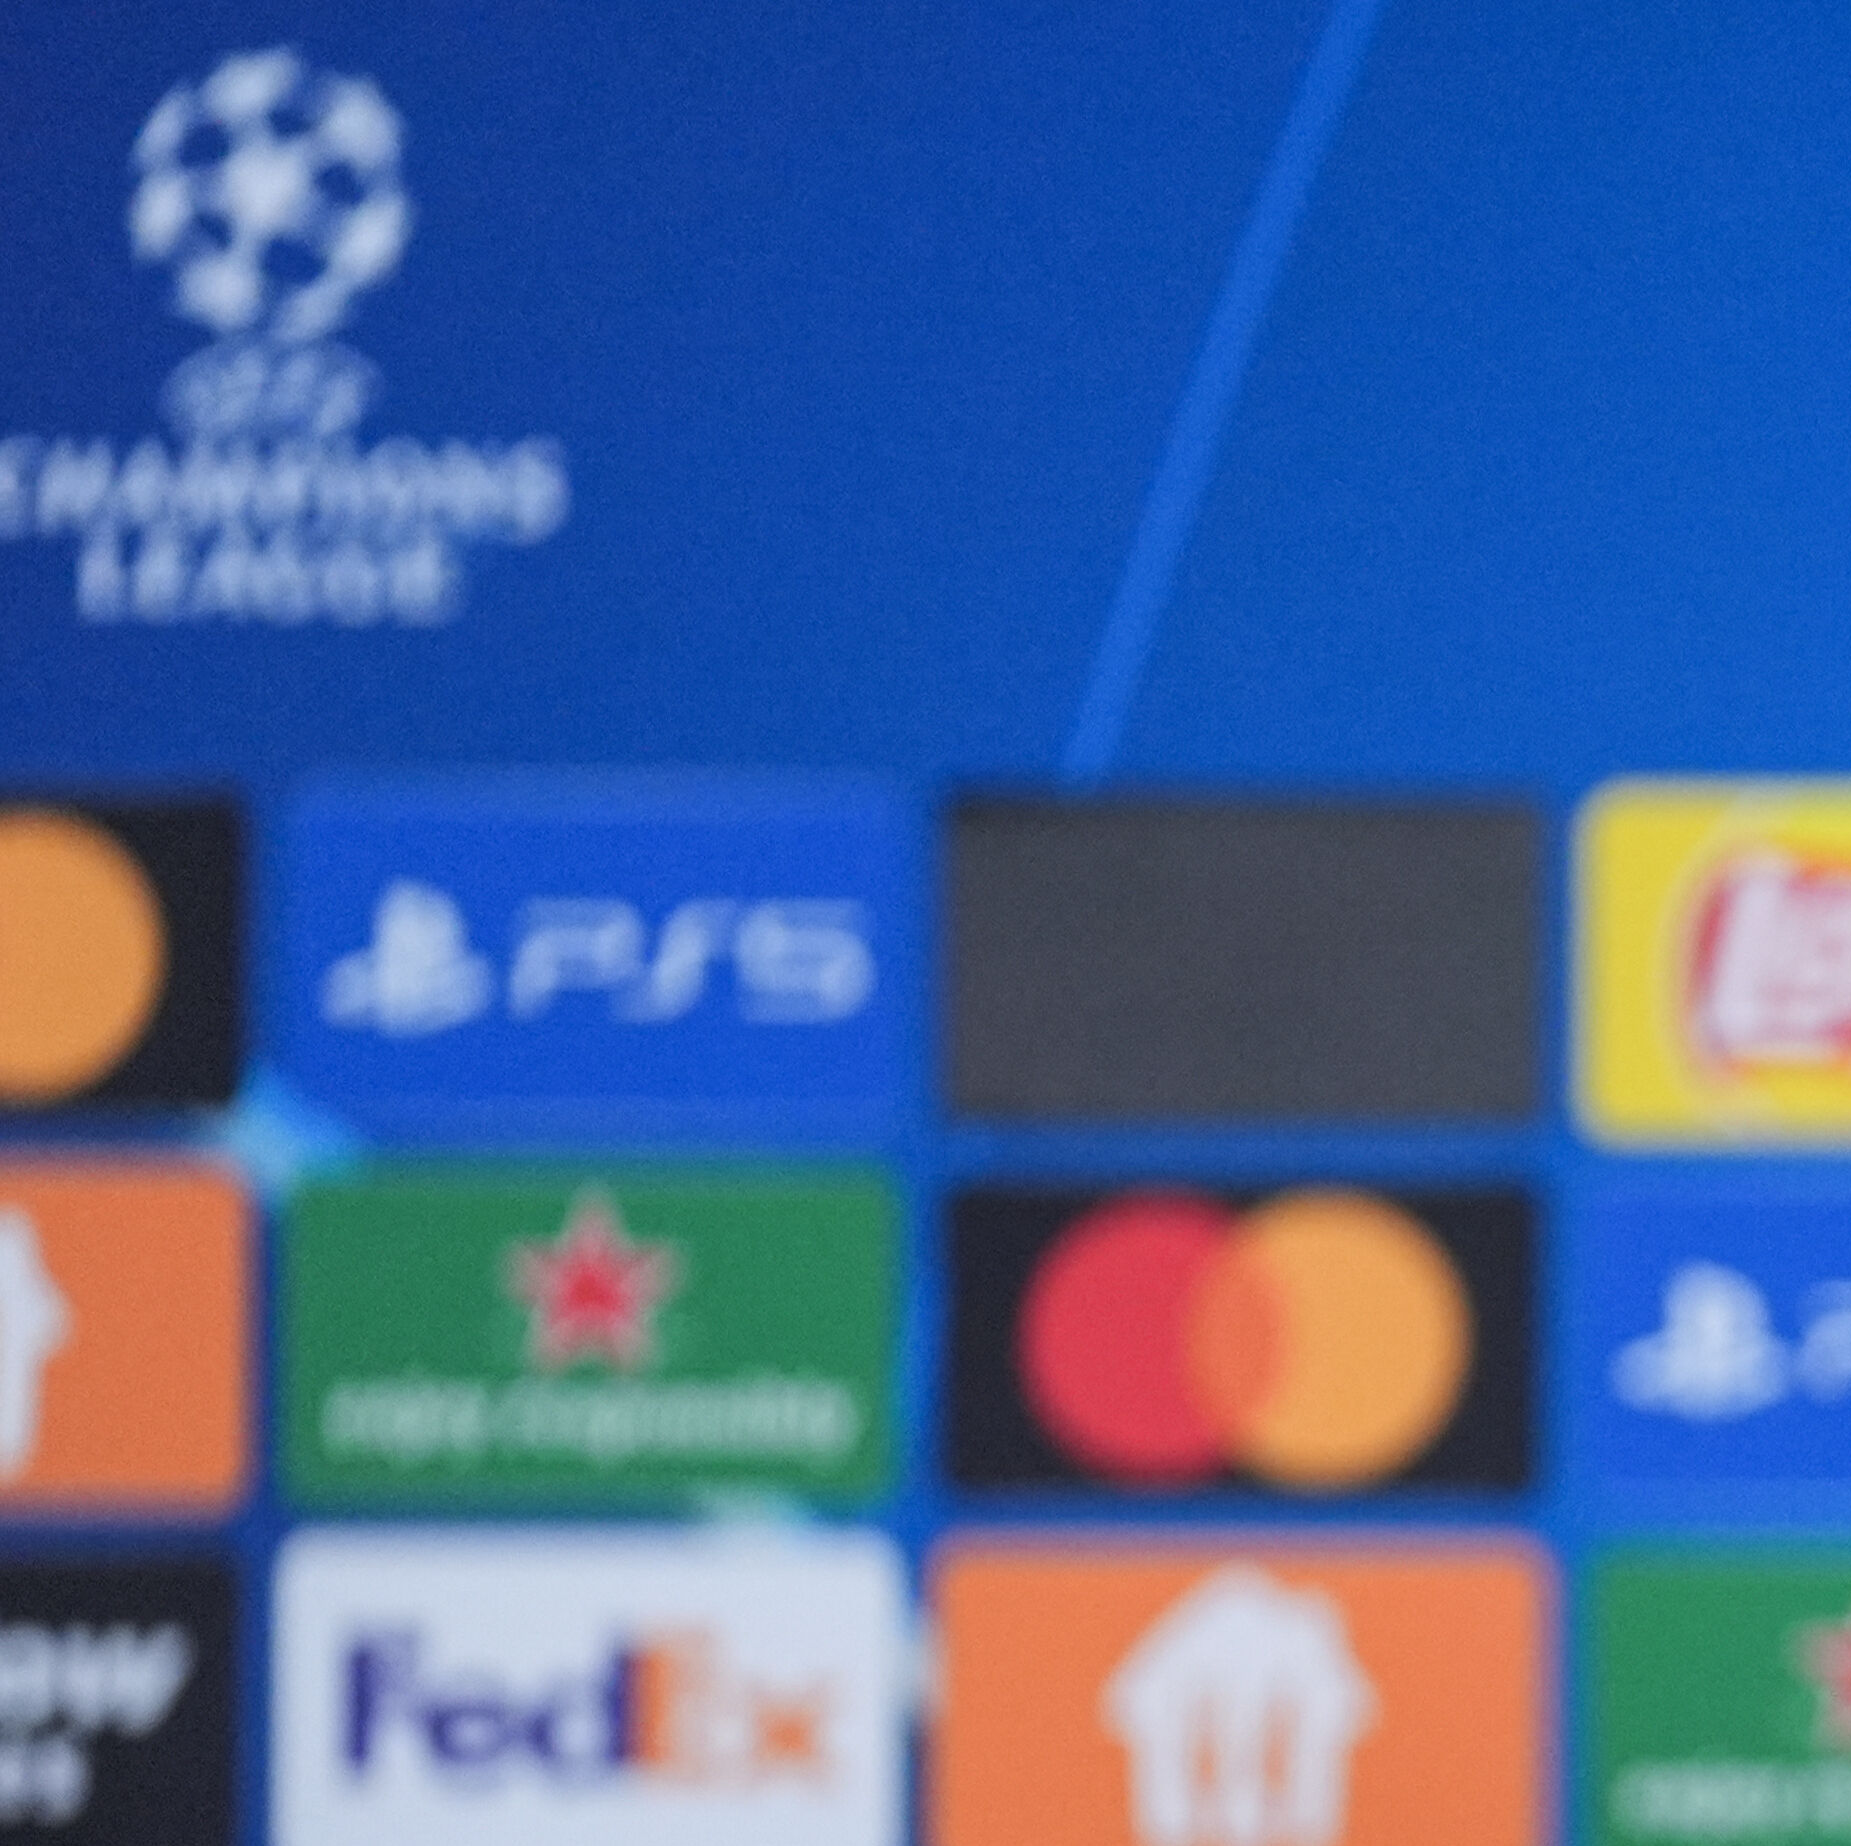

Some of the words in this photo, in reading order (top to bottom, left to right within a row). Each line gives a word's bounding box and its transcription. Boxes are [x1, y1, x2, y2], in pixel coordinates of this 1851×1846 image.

[79, 535, 455, 622] LEAGUE
[510, 900, 873, 1020] PS5
[340, 1630, 828, 1780] FedEx
